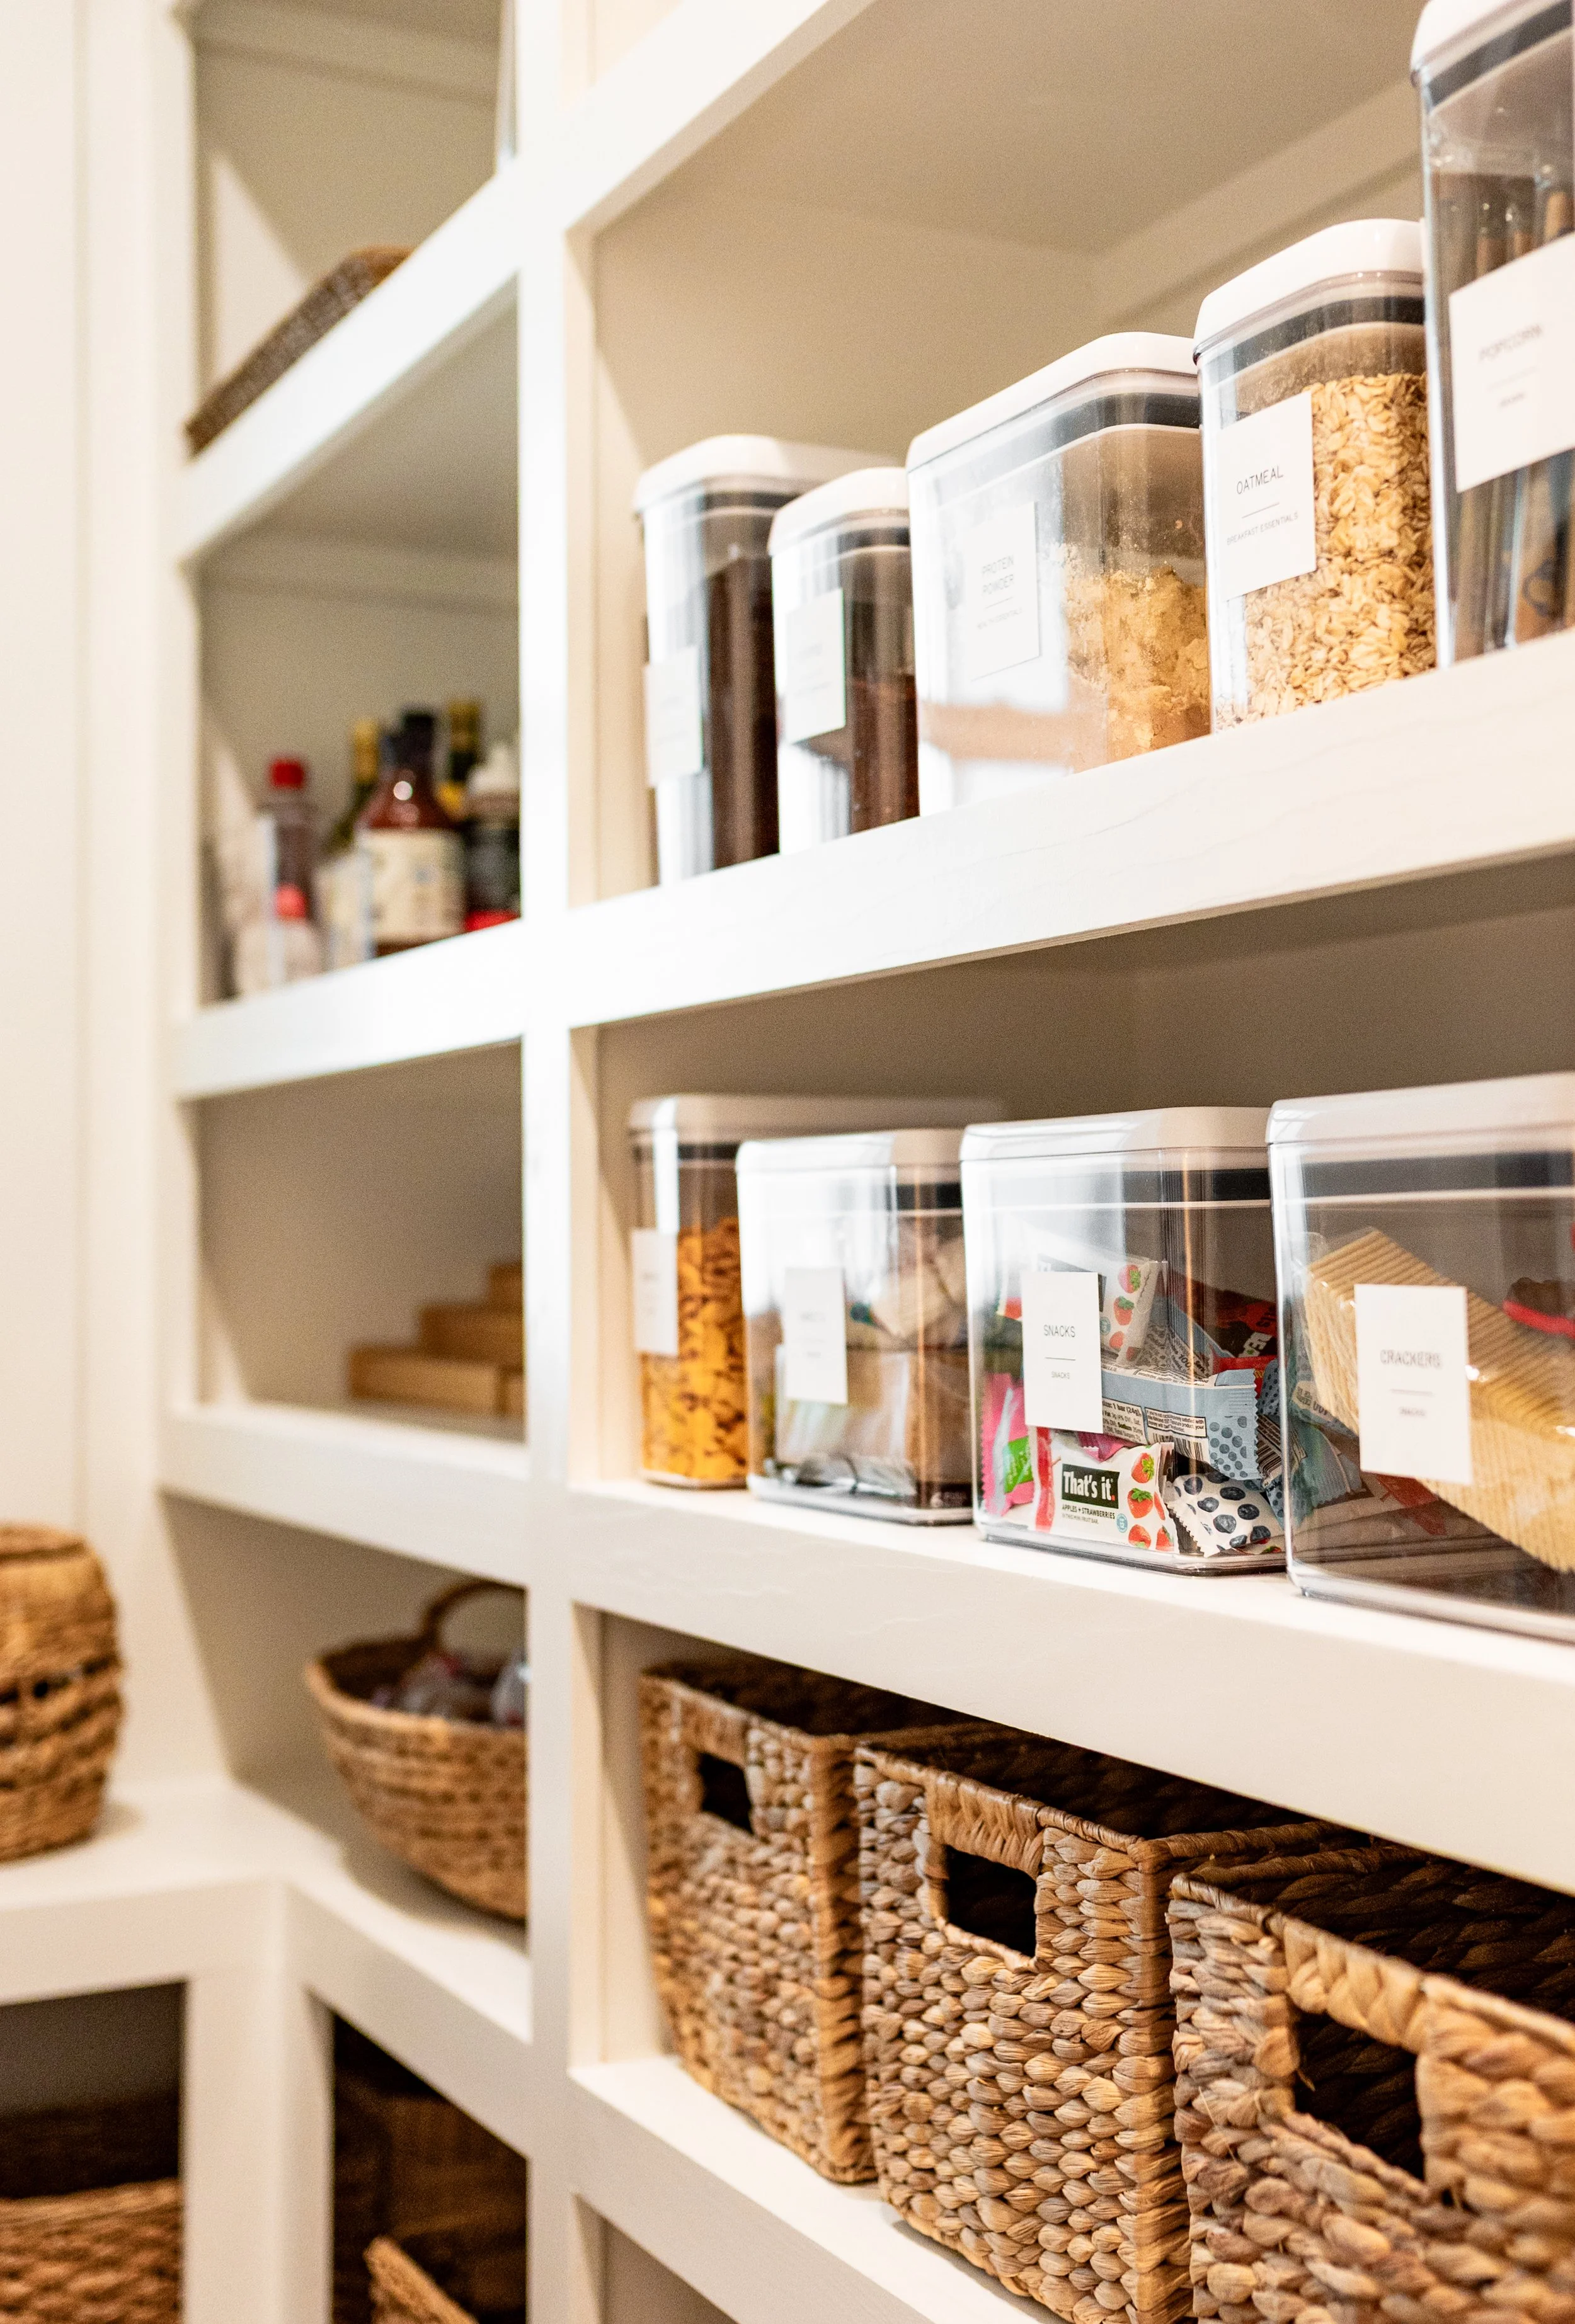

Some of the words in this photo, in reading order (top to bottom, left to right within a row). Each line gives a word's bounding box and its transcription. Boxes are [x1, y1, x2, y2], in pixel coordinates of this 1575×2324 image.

[1236, 465, 1284, 494] OATMEAL
[1226, 526, 1258, 545] BREAKFAST
[1259, 511, 1299, 532] ESSENTIALS
[1043, 1324, 1075, 1338] SNACKS
[1380, 1349, 1443, 1370] CRACKERS
[1051, 1370, 1070, 1379] SNACKS
[1063, 1471, 1097, 1498] That's
[1101, 1476, 1115, 1501] it.
[1062, 1504, 1077, 1513] APPLES
[1082, 1507, 1115, 1520] STRAWBERRIES
